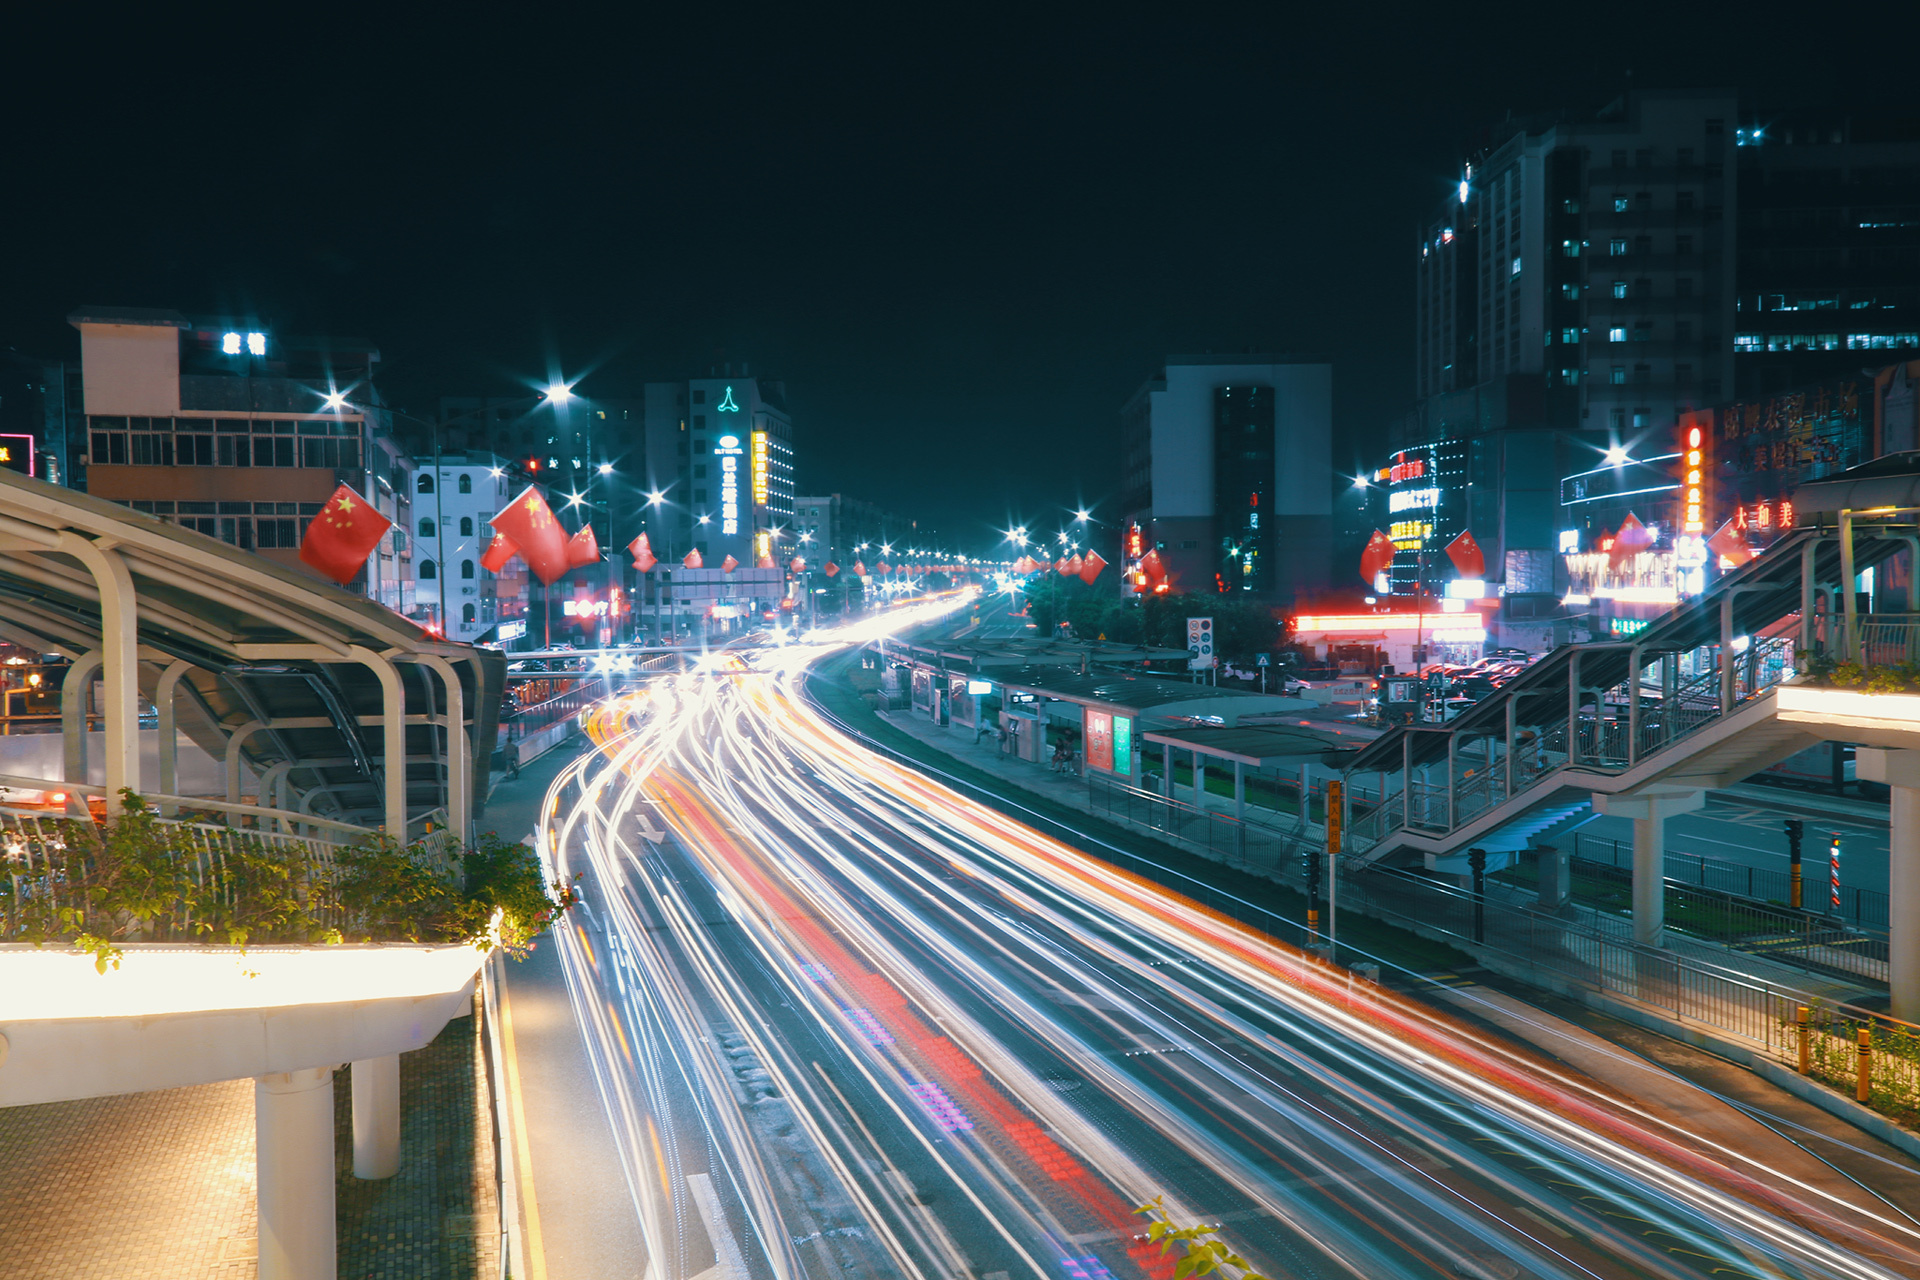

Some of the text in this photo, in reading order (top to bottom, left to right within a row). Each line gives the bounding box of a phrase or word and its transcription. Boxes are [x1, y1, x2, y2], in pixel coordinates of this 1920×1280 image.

[1330, 783, 1339, 852] 严禁入轨行区
